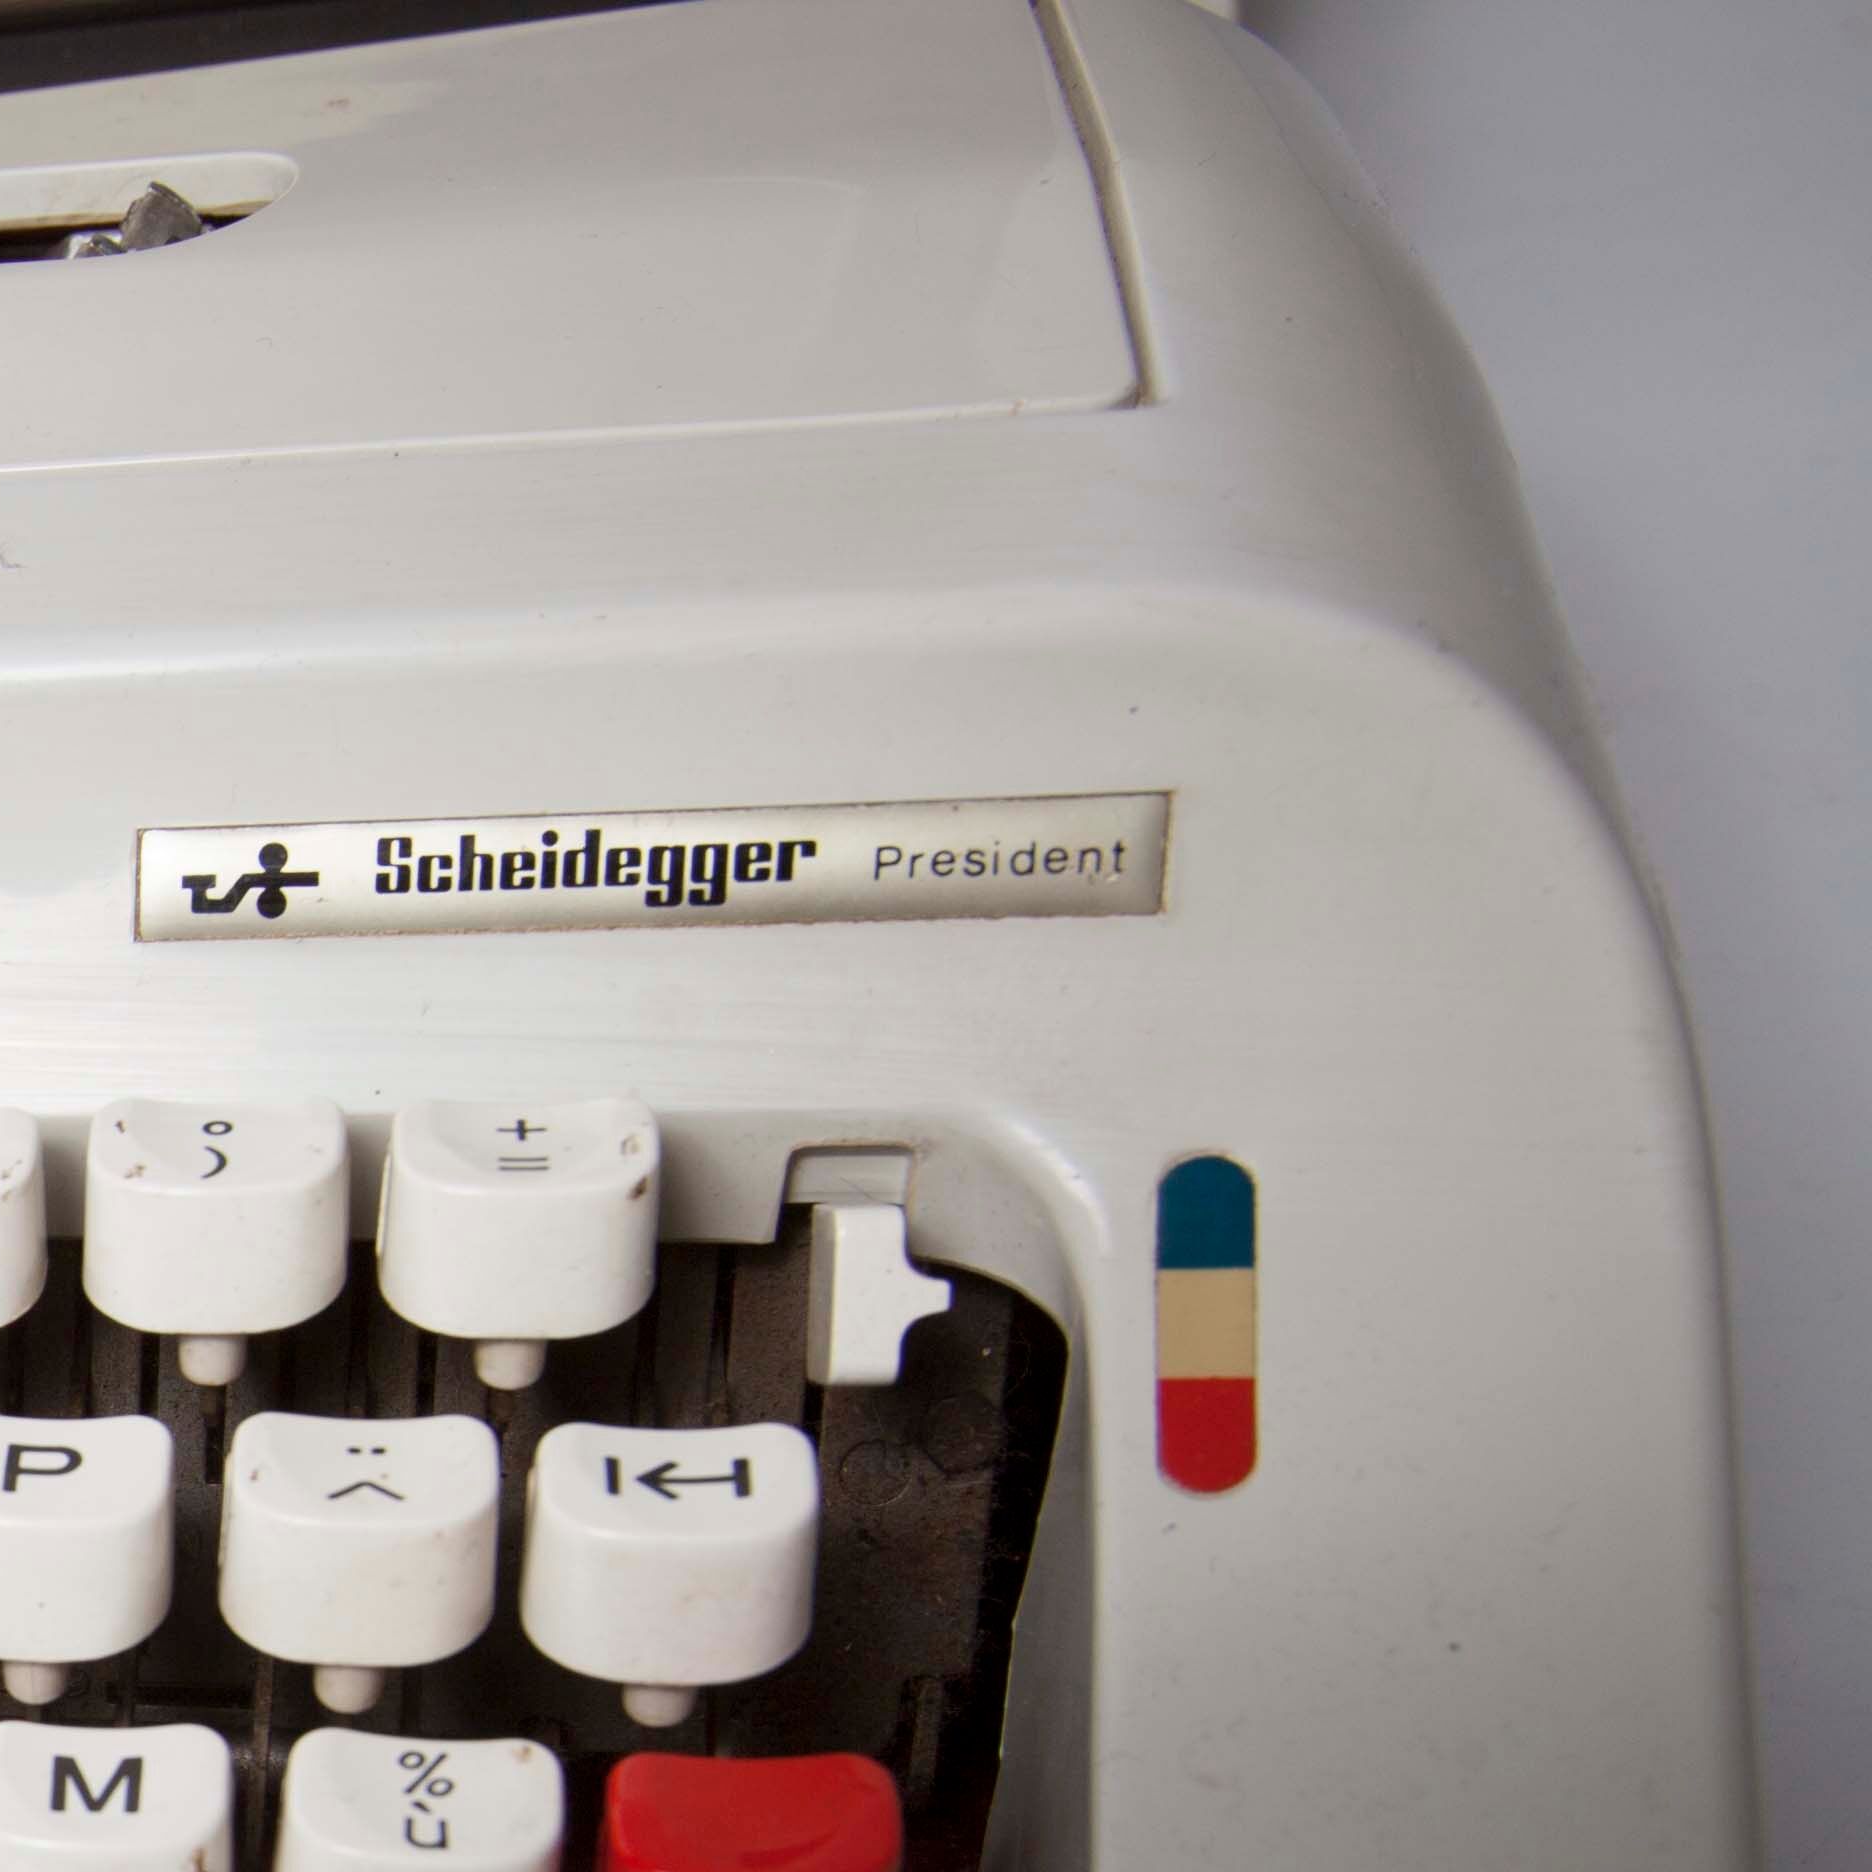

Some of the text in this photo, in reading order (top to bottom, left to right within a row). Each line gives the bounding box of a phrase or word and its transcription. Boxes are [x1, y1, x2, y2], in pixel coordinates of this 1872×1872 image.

[374, 828, 1126, 909] Scheidegger President
[2, 1443, 83, 1493] P
[50, 1755, 143, 1814] M
[398, 1751, 455, 1797] %
[405, 1801, 448, 1849] ù
